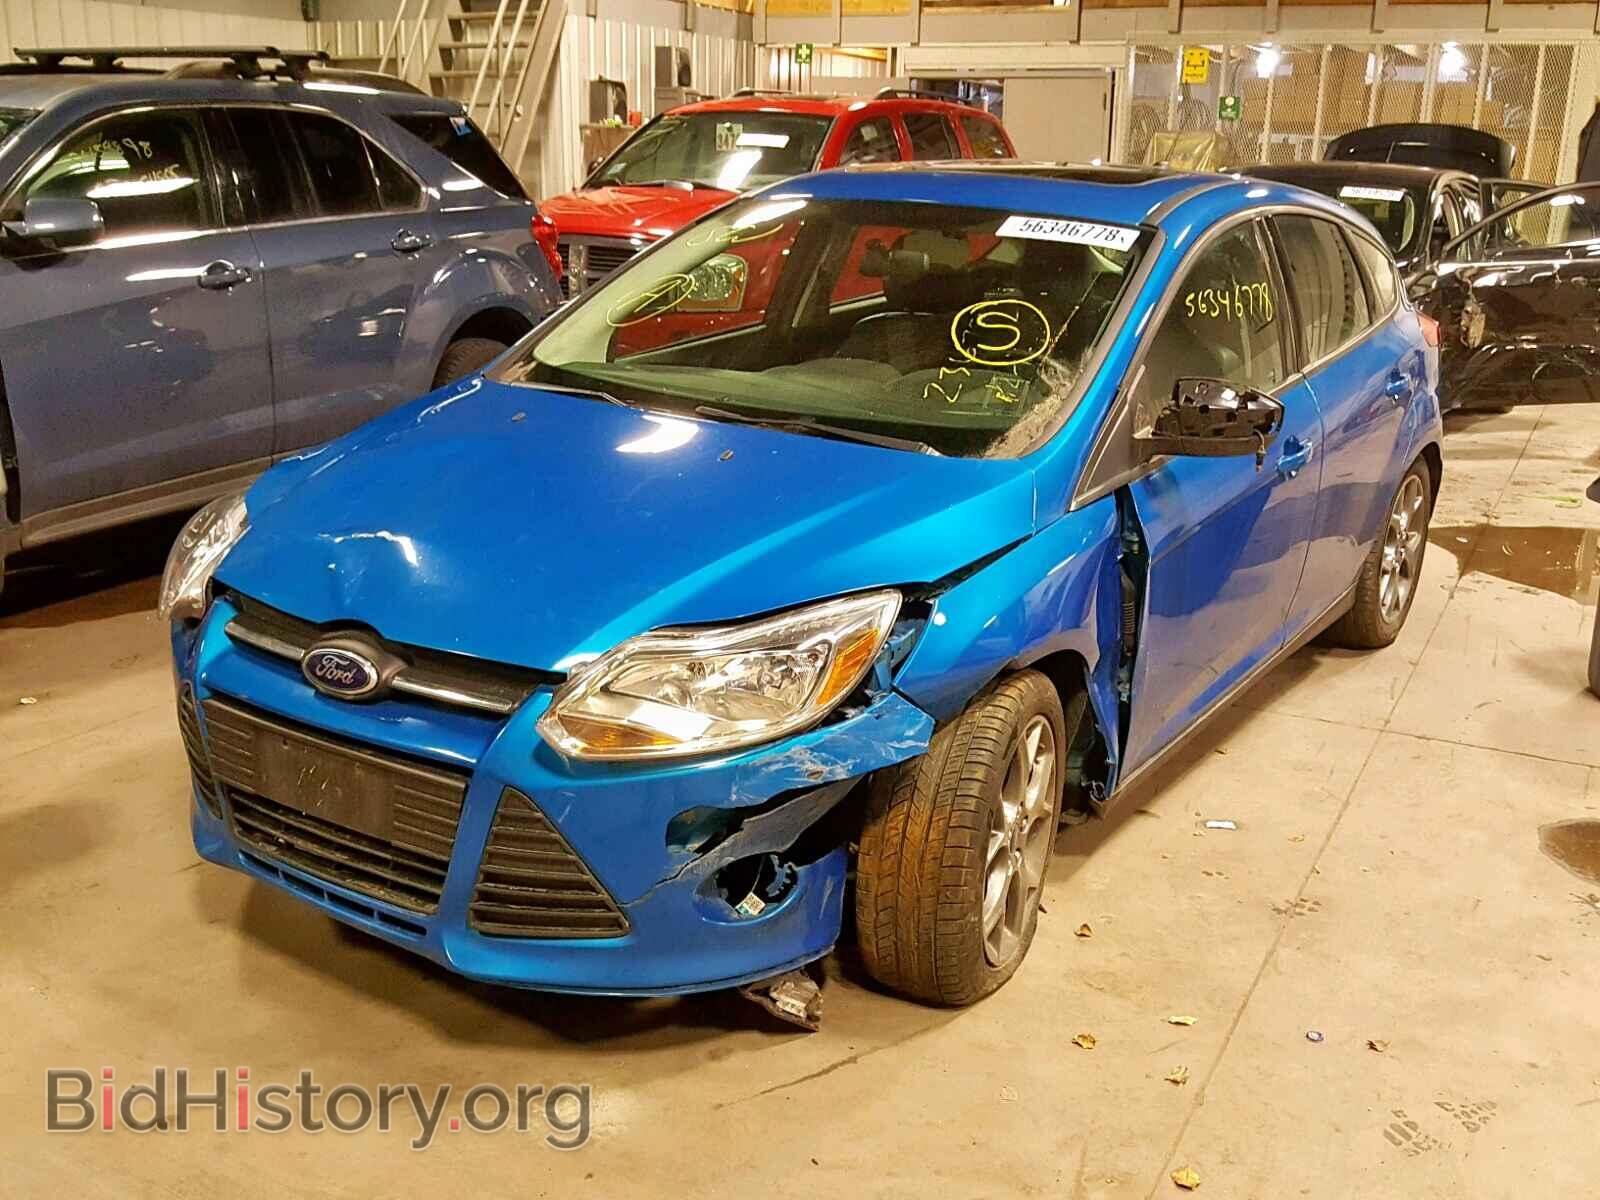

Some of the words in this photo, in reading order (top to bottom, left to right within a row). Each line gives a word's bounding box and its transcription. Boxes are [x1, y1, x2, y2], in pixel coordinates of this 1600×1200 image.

[1019, 218, 1121, 244] 56346778
[1185, 282, 1273, 322] 56346778
[976, 312, 1020, 350] S
[315, 655, 357, 685] Ford
